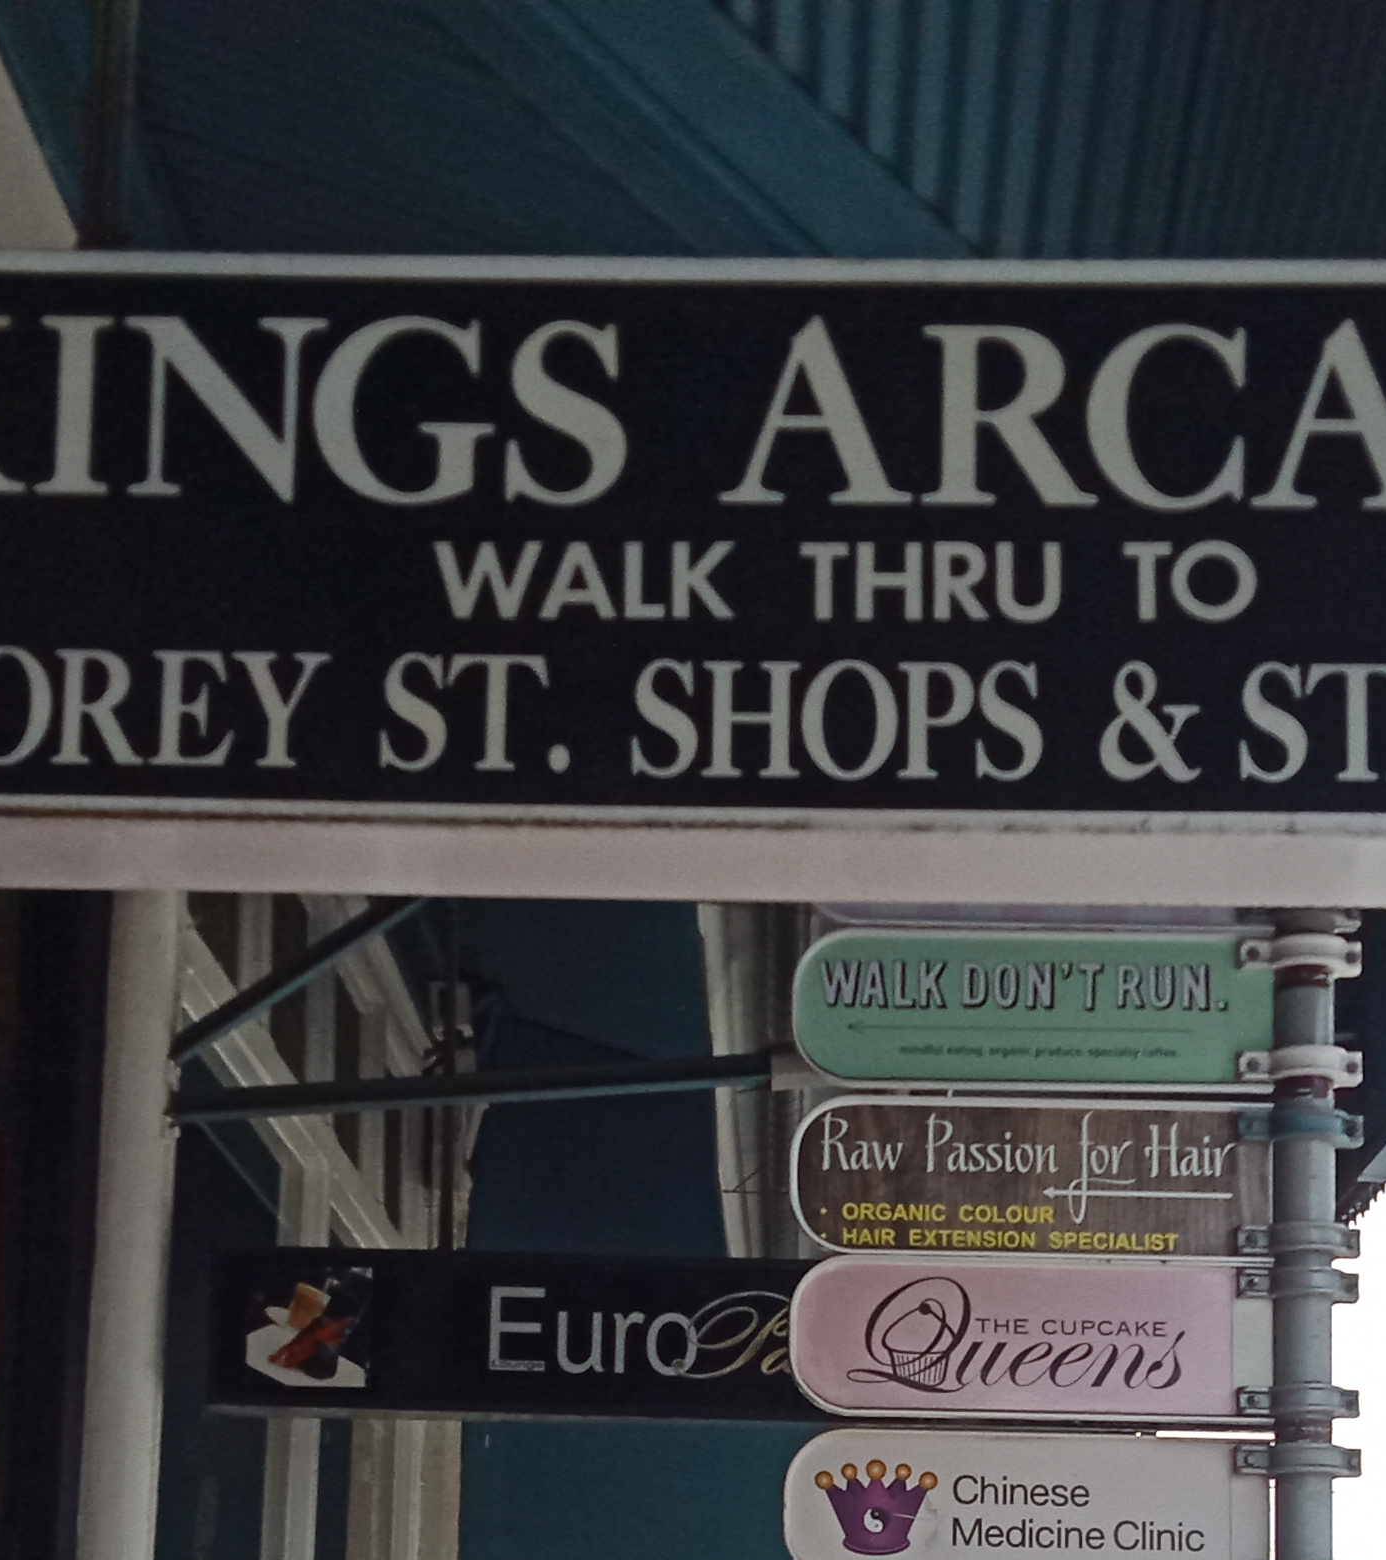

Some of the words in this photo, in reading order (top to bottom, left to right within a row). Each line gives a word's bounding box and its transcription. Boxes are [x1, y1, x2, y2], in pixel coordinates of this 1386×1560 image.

[433, 541, 735, 620] WALK
[800, 541, 1062, 623] THRU
[1122, 541, 1258, 622] TO
[379, 652, 571, 774] ST.
[629, 657, 1043, 782] SHOPS
[1099, 660, 1201, 783] &
[820, 960, 947, 1010] WALK
[962, 960, 1104, 1012] DON'T
[1115, 963, 1229, 1012] RUN.
[820, 1111, 904, 1172] Raw
[925, 1113, 1059, 1174] Passion
[1068, 1111, 1136, 1224] for
[1144, 1122, 1235, 1178] Hair
[842, 1204, 946, 1223] ORGANIC
[959, 1205, 1055, 1224] COLOUR
[842, 1229, 896, 1247] HAIR
[909, 1230, 1037, 1249] EXTENSION
[1049, 1232, 1179, 1252] SPECIALIST
[488, 1285, 697, 1377] Euro
[846, 1276, 1186, 1393] Queens
[976, 1318, 1028, 1336] THE
[1041, 1319, 1168, 1337] CUPCAKE
[952, 1475, 1090, 1507] Chinese
[951, 1517, 1104, 1550] Medicine
[1114, 1521, 1205, 1553] Clinic
